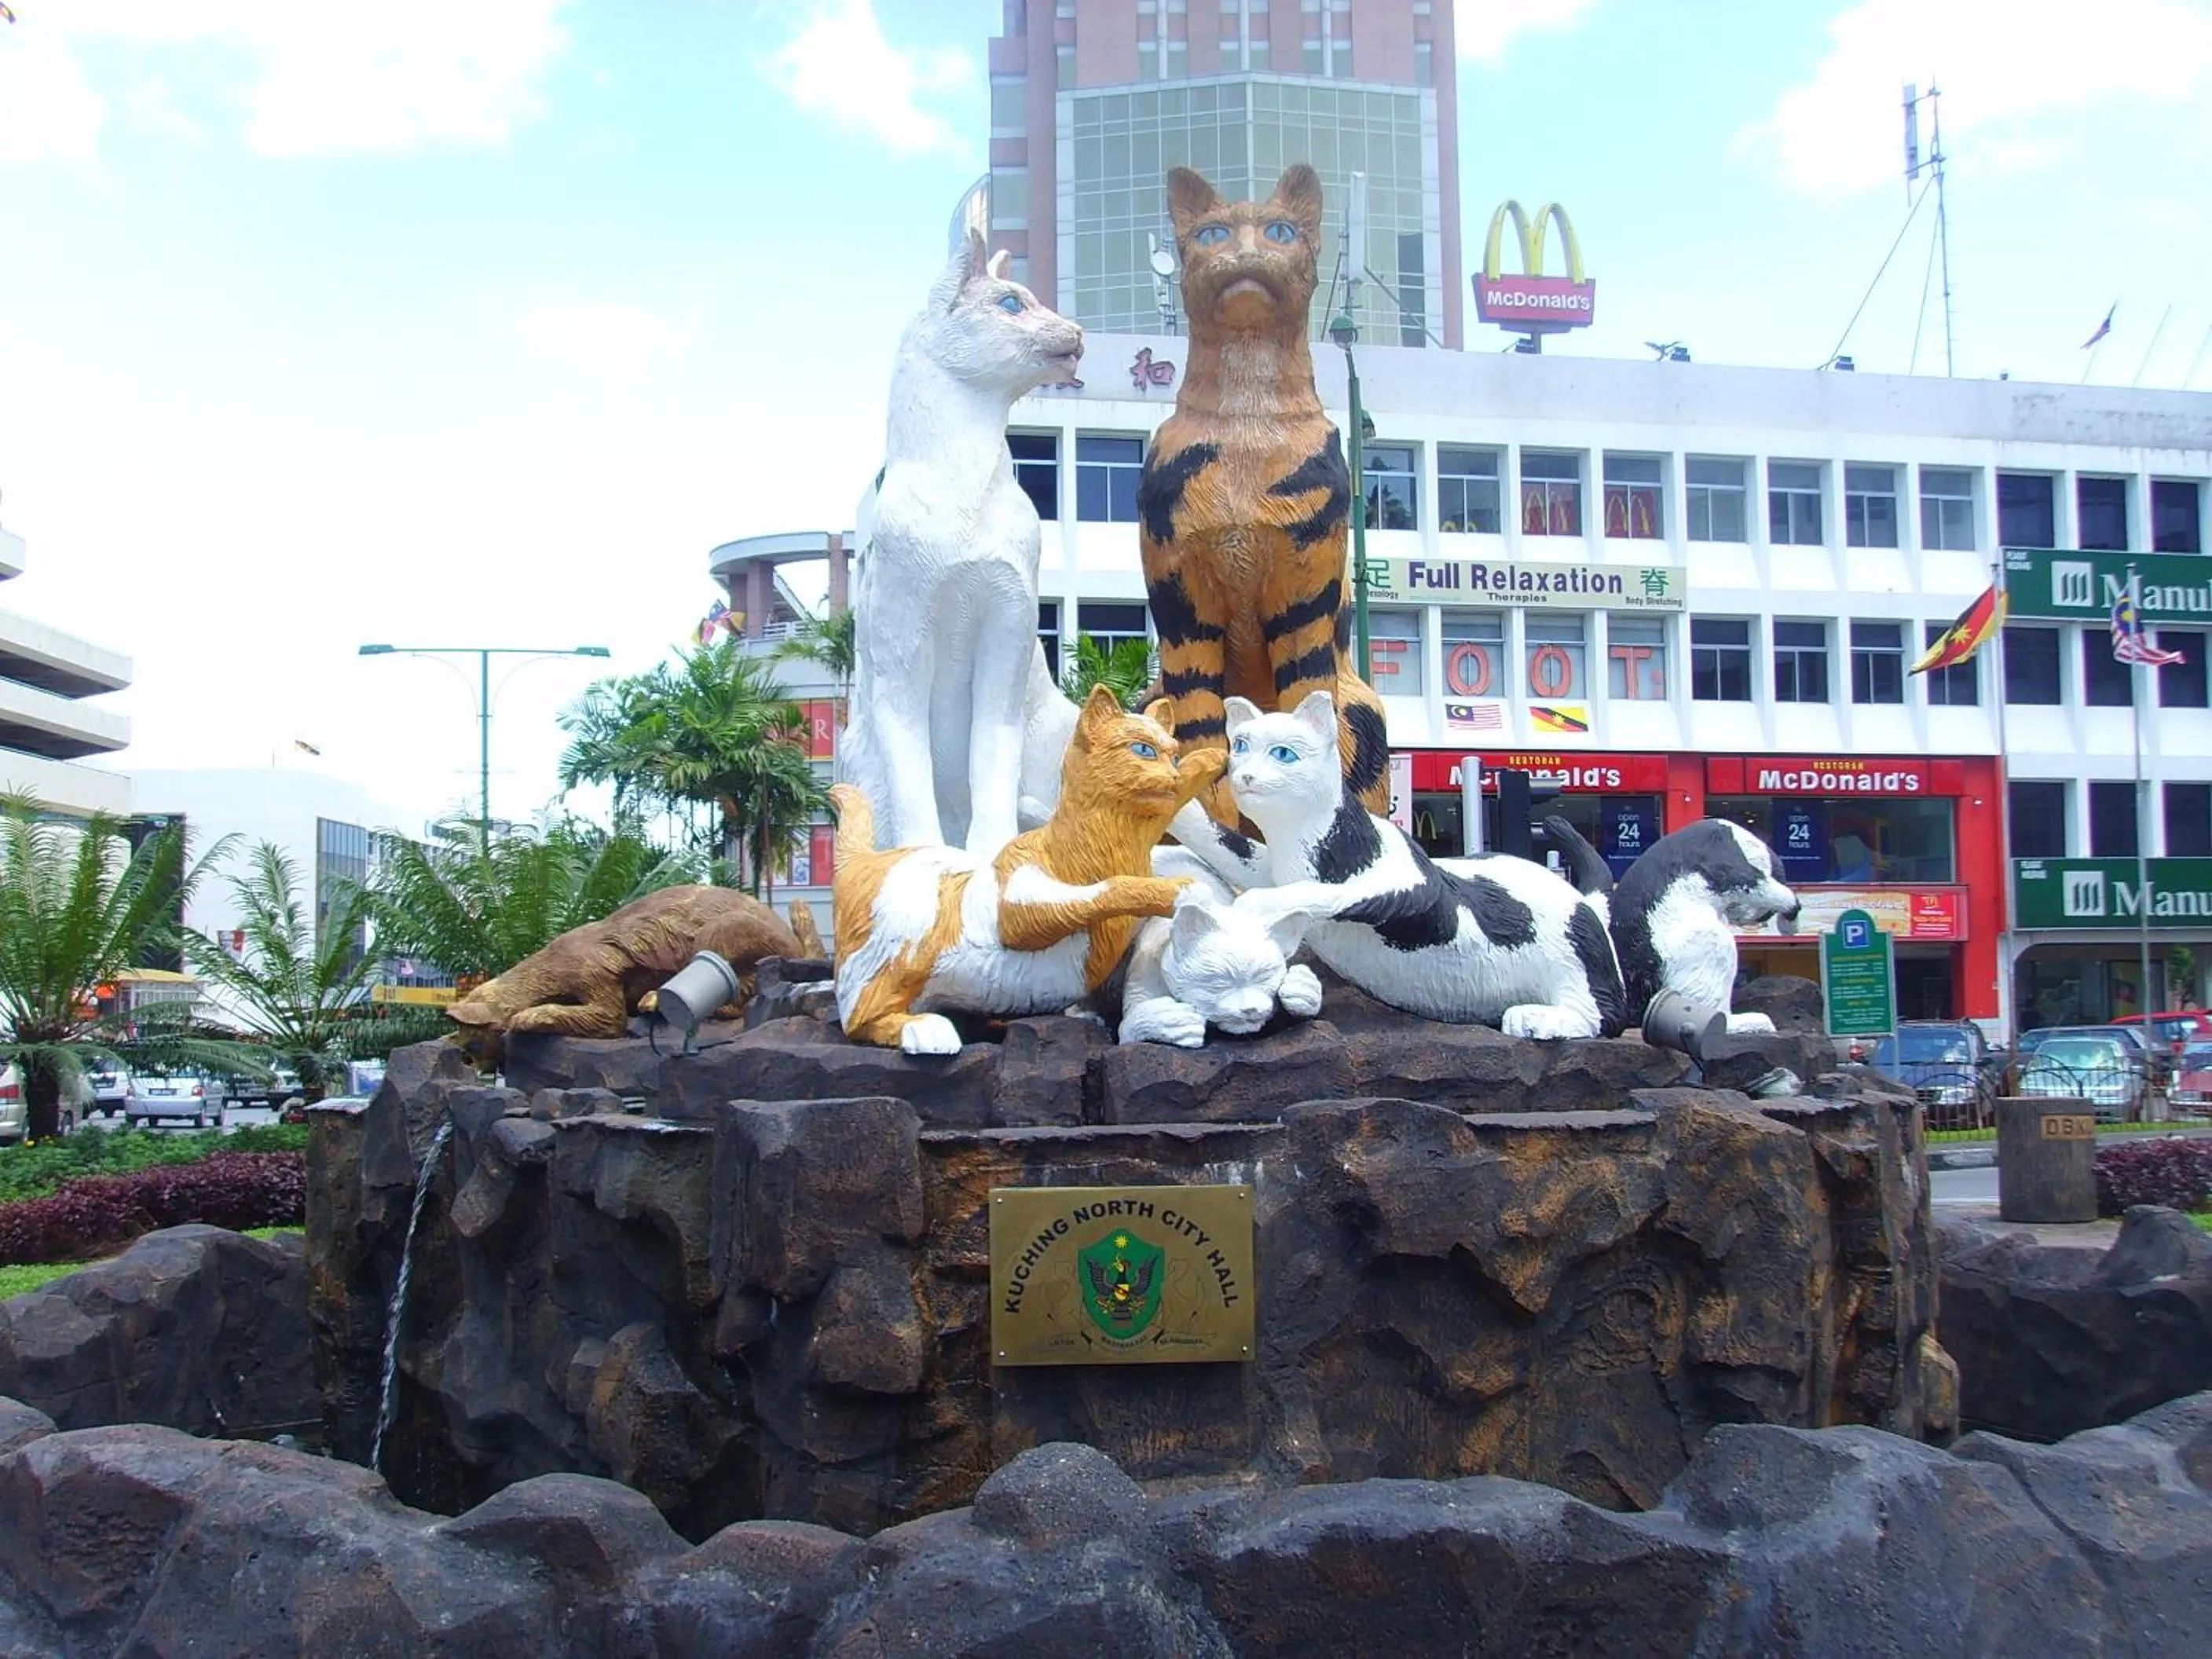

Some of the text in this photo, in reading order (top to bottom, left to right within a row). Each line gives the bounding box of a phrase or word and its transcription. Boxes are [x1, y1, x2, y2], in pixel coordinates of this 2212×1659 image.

[1487, 291, 1591, 310] McDonald's
[1408, 562, 1623, 594] Full Relaxation
[1640, 569, 1669, 596] 脊
[1489, 592, 1547, 603] Therapies
[1759, 770, 1921, 791] McDonald's
[1618, 822, 1640, 840] 24
[1789, 823, 1810, 840] 24
[1847, 925, 1863, 943] P
[1005, 1199, 1240, 1314] KUCHING NORTH CITY HALL
